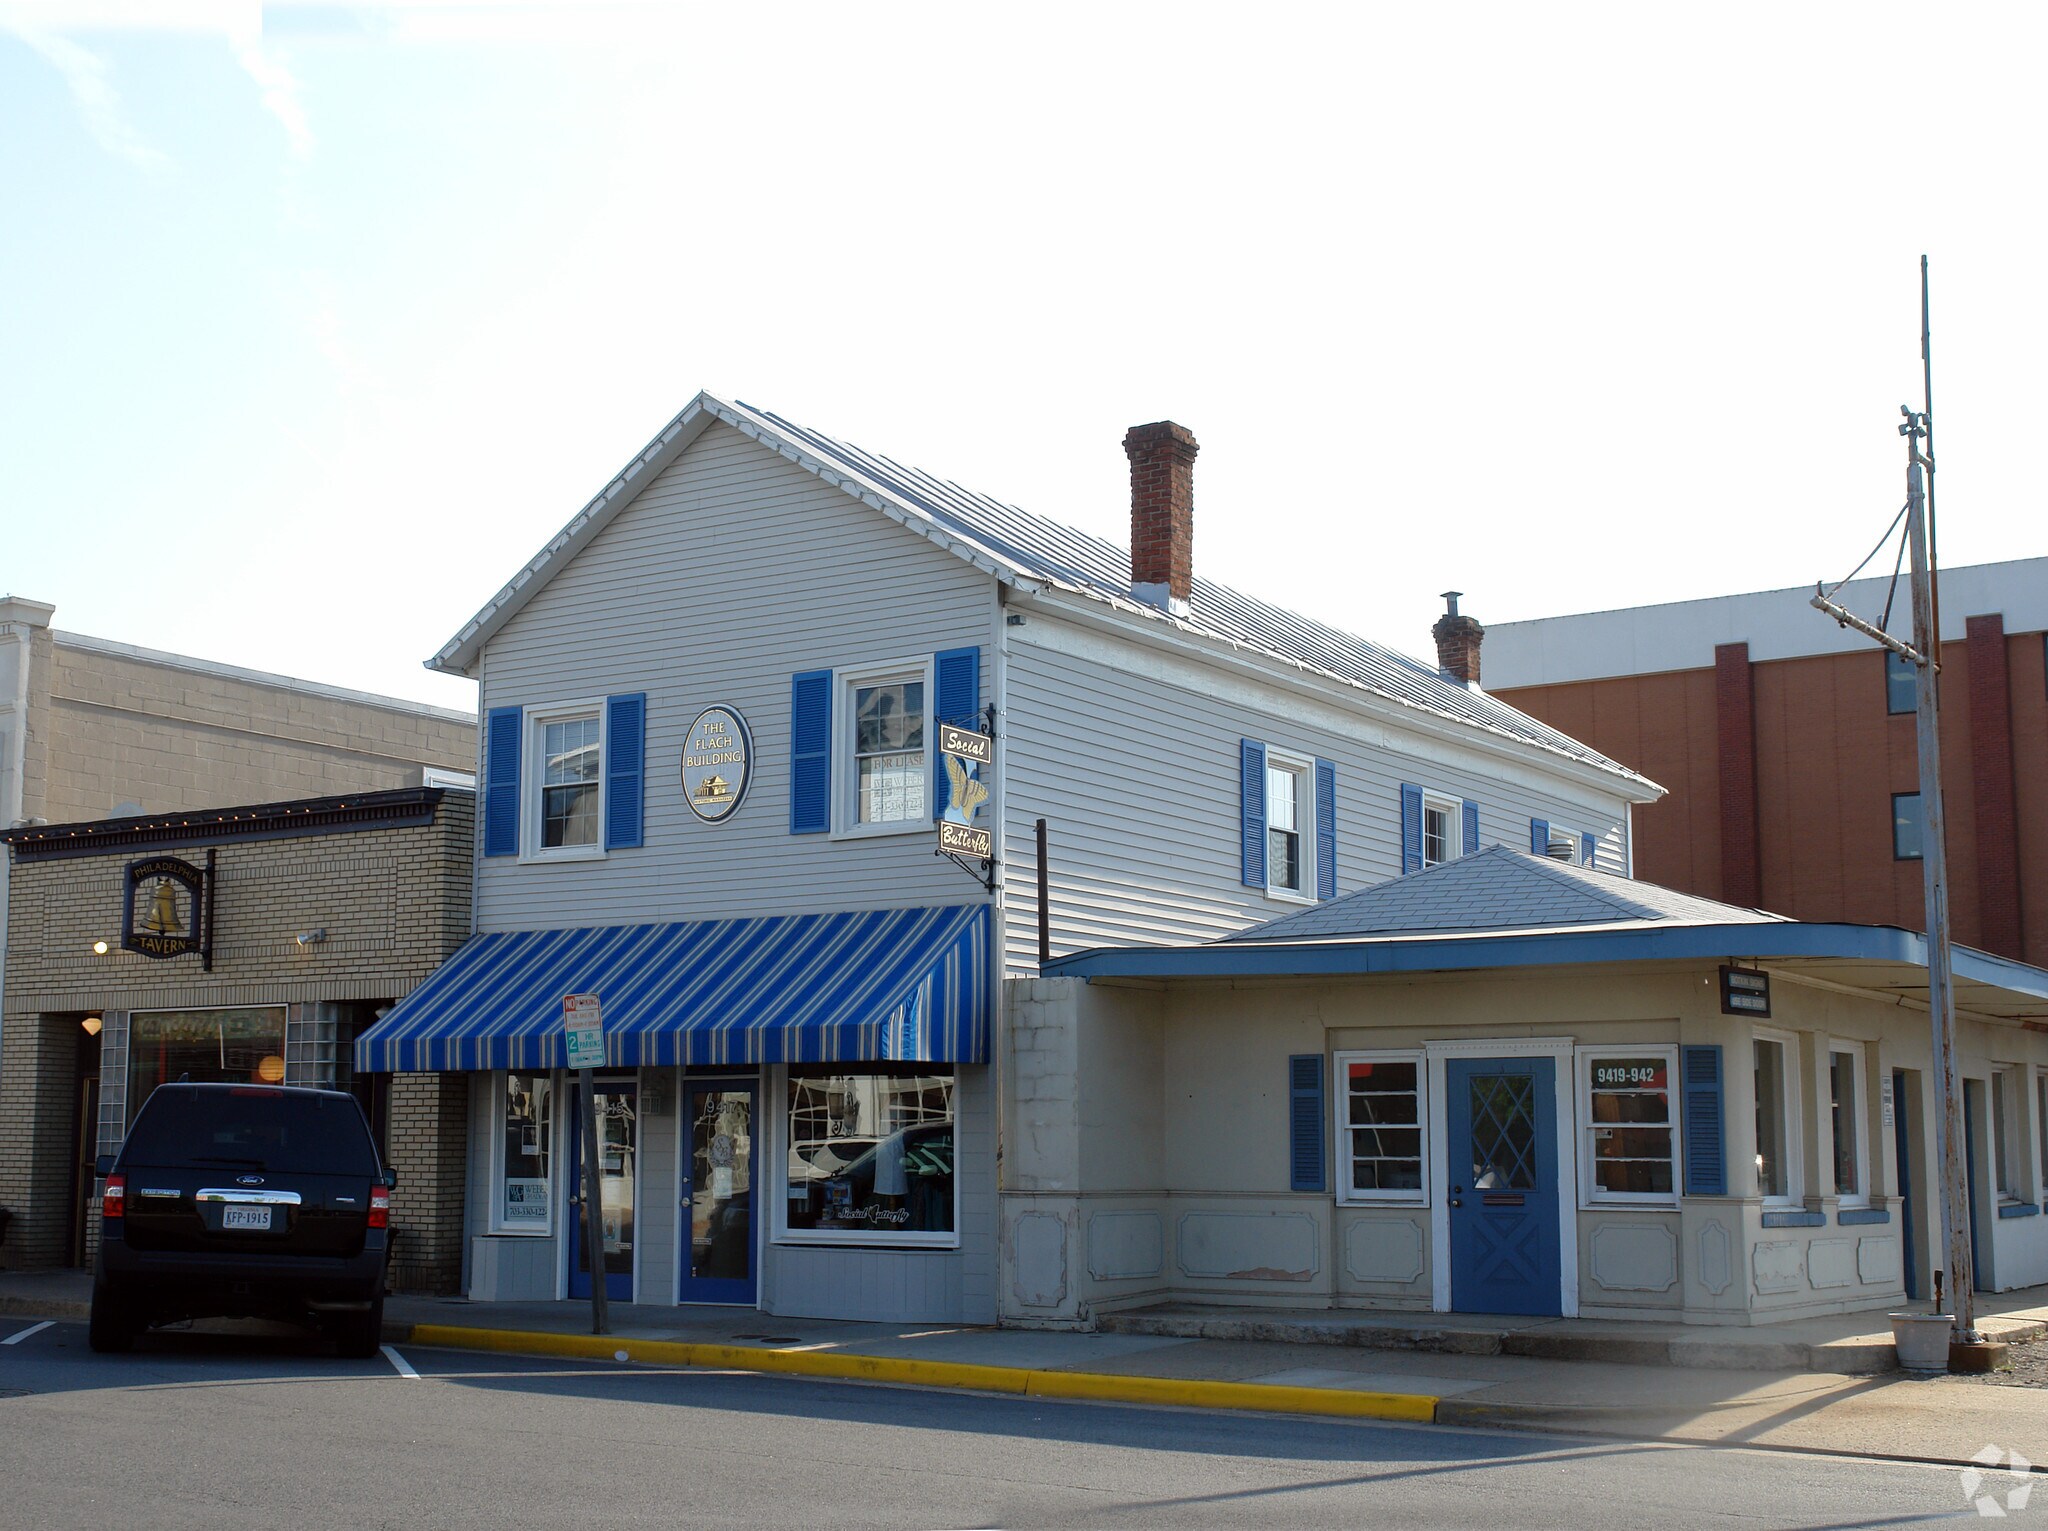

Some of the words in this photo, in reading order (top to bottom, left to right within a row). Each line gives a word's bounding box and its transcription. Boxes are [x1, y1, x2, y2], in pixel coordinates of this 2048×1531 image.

[703, 722, 725, 735] THE
[695, 736, 733, 751] FLACH
[947, 731, 985, 755] Social
[687, 750, 741, 767] BUILDING
[893, 775, 923, 786] WBER
[943, 825, 989, 854] Butterfly
[134, 862, 198, 884] PHILADELPHIA
[140, 937, 186, 953] TAVERN
[565, 998, 575, 1009] NO
[576, 998, 598, 1007] PARKING
[568, 1035, 577, 1050] 2
[585, 1032, 594, 1040] HR
[579, 1040, 601, 1049] PARKING
[1598, 1067, 1654, 1082] 9419-942
[706, 1100, 737, 1113] 9417
[525, 1184, 547, 1194] WEBE
[226, 1211, 269, 1223] KFP-1915
[838, 1206, 869, 1219] Social
